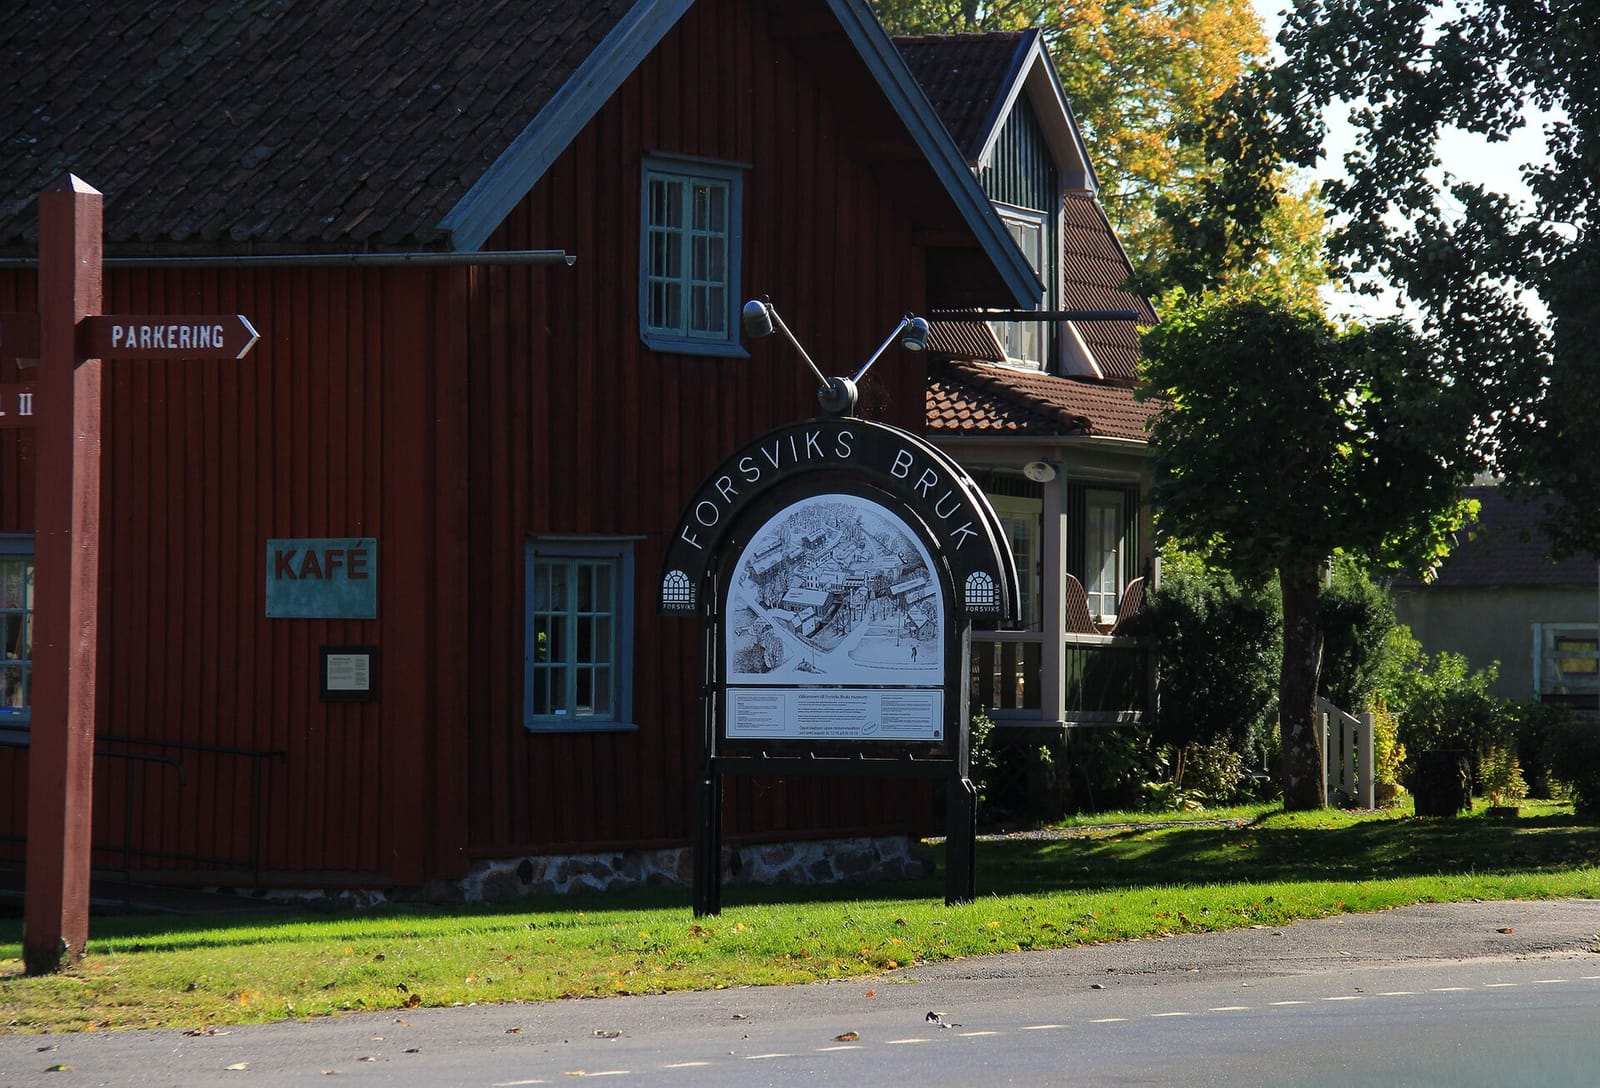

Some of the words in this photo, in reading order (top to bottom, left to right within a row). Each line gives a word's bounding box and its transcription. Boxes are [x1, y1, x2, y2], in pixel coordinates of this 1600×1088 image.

[112, 325, 224, 348] PARKERING
[680, 430, 856, 551] FORSVIKS
[889, 449, 979, 551] BRUK
[274, 540, 369, 580] KAFÉ
